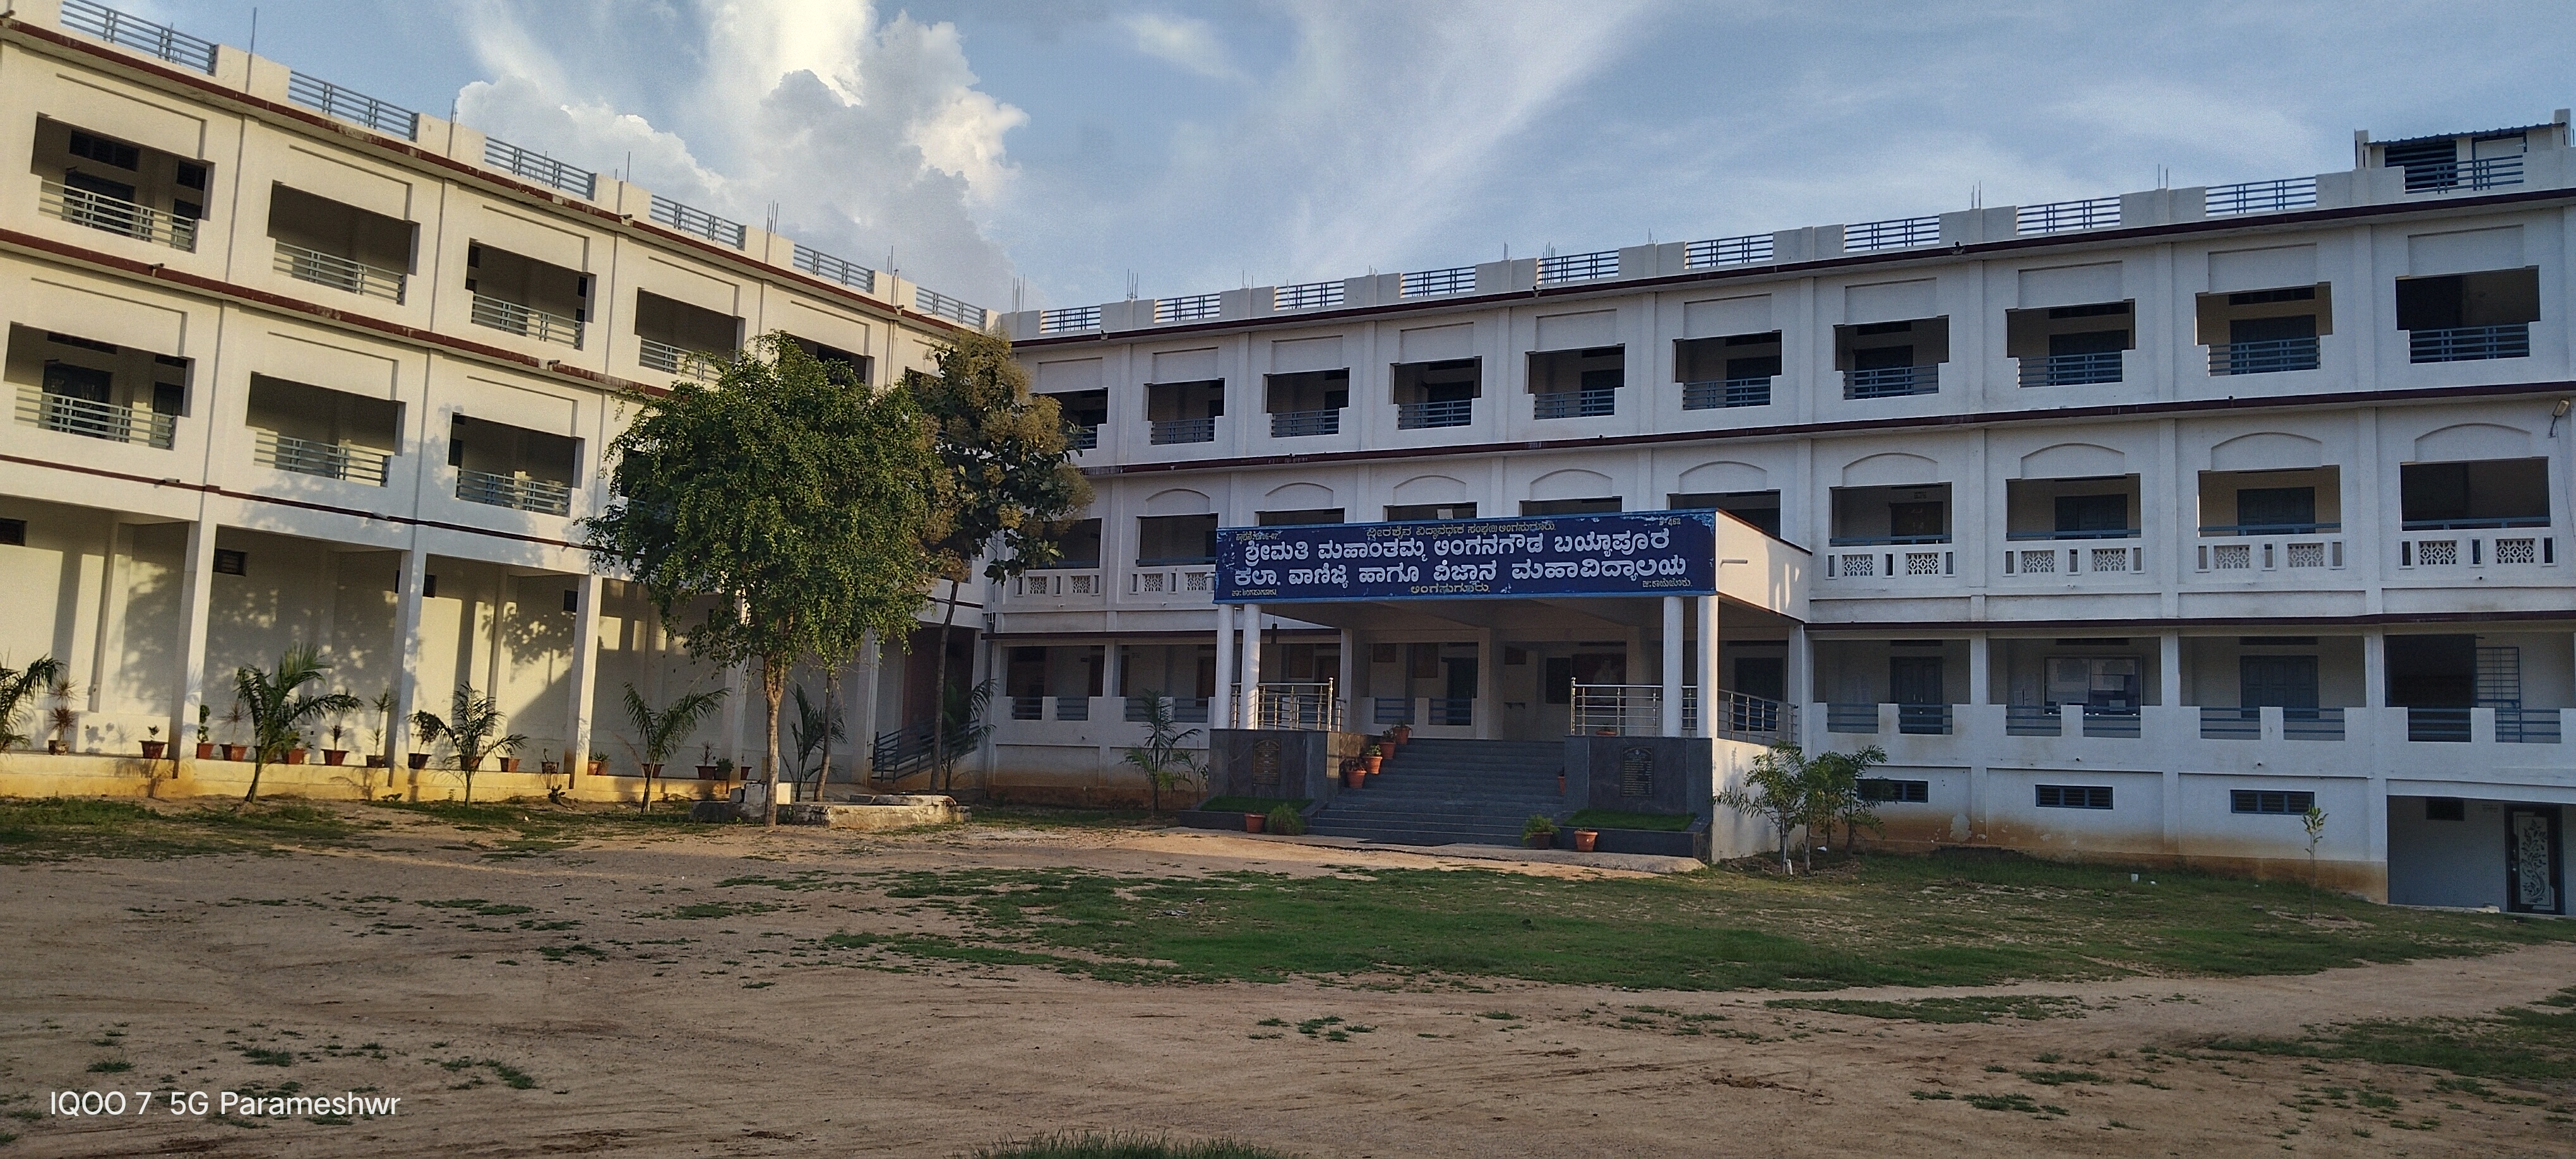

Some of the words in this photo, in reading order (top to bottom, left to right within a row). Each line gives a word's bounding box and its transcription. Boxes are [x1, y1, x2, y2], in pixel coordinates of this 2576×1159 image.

[1245, 540, 1309, 567] ಶ್ರೀಮತಿ
[1318, 537, 1428, 562] ಮಹಾಂತಮ್ಮ
[1434, 532, 1544, 556] ಲಿಂಗನಗೌಡ
[1554, 528, 1669, 557] ಬಯ್ಯಾಪೂರ
[1366, 525, 1411, 539] ವೀರಶೈವ
[1288, 562, 1349, 588] ವಾಣಿಜ್ಯ
[1359, 562, 1419, 583] ಹಾಗೂ
[1433, 559, 1497, 586] ವಿಜ್ಞಾನ
[1512, 555, 1686, 581] ಮಹಾವಿದ್ಯಾಲಯ
